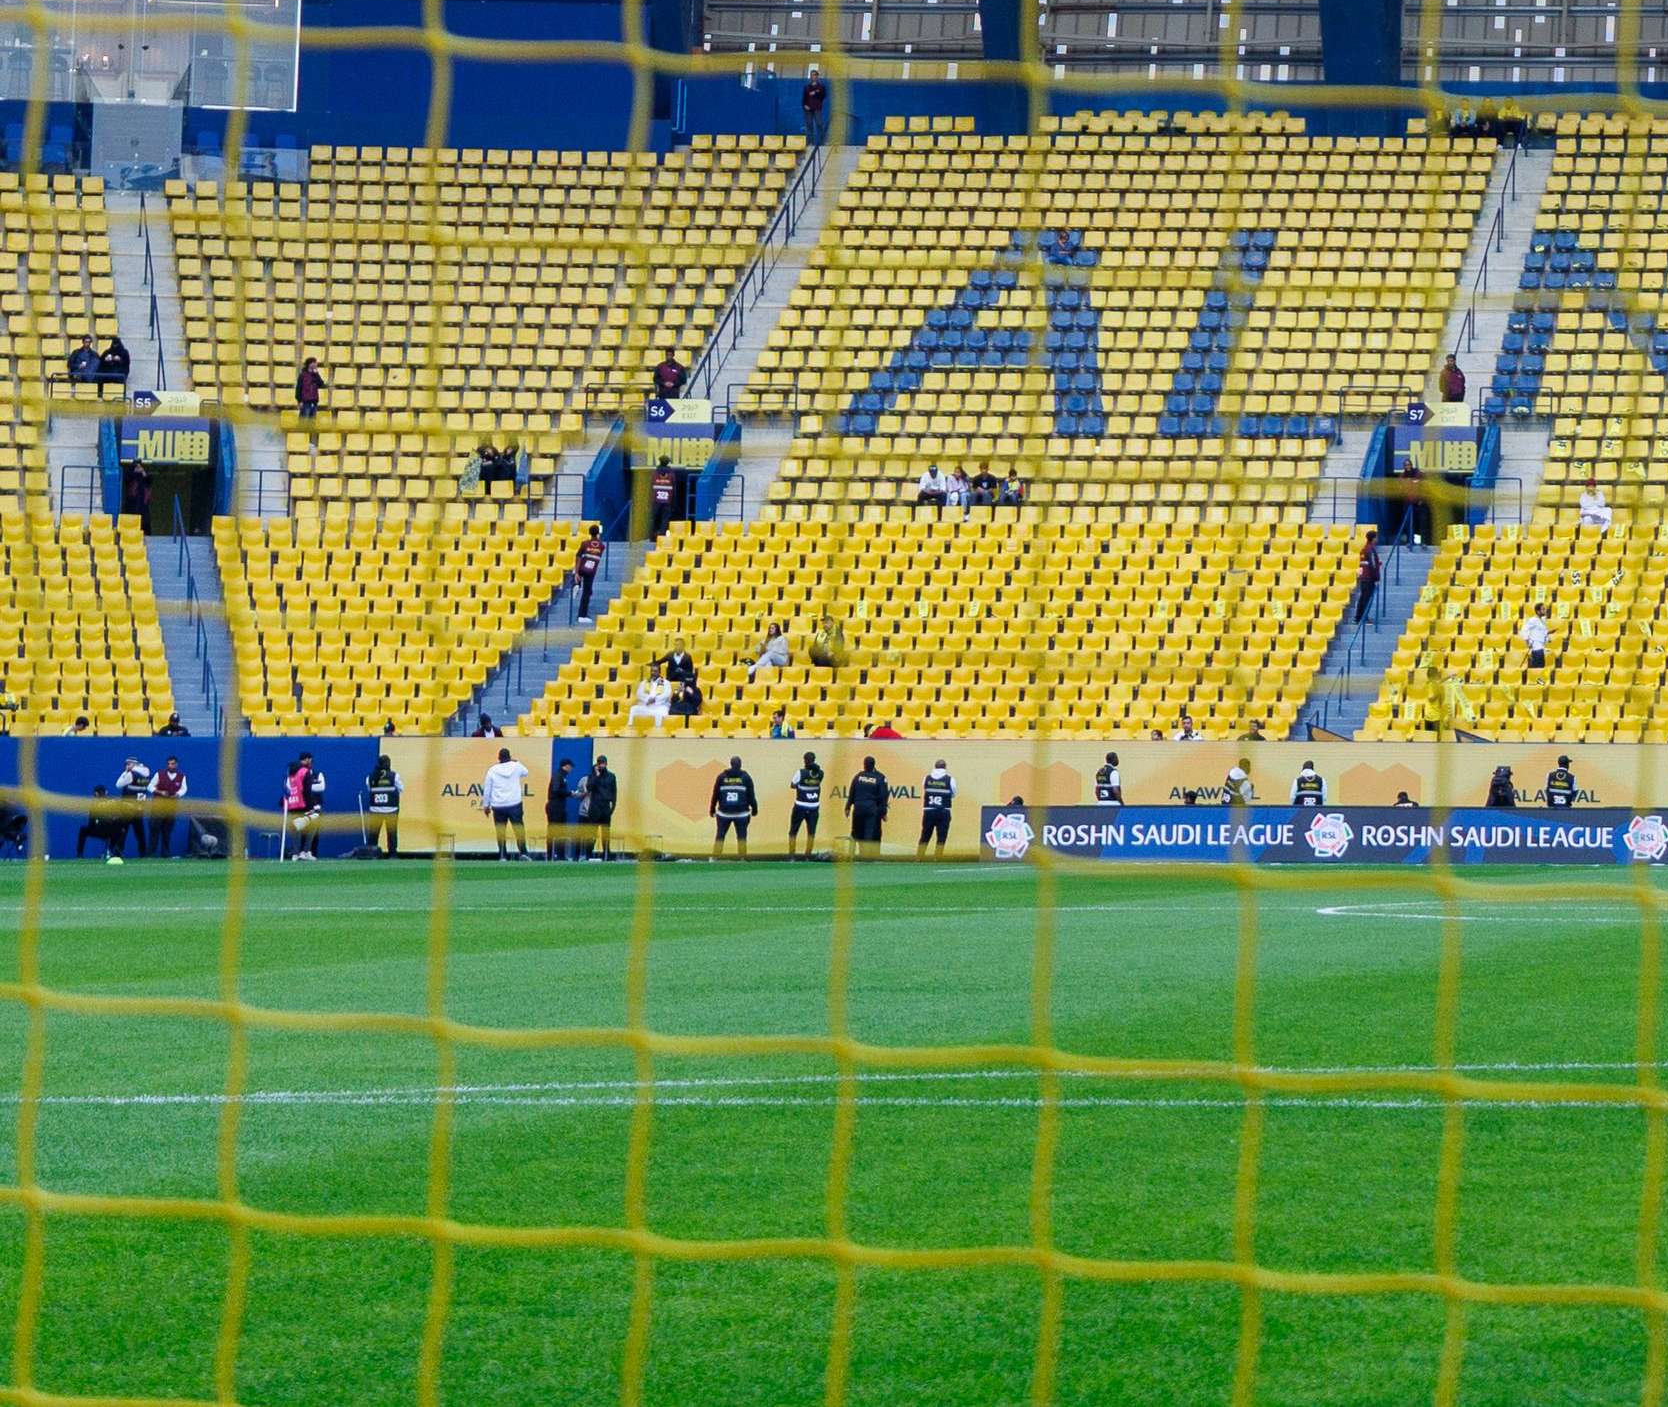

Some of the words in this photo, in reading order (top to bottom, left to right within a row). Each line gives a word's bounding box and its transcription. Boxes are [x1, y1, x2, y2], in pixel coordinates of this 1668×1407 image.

[834, 227, 1336, 439] AL
[135, 397, 152, 408] S5
[650, 406, 666, 417] S6
[1409, 409, 1424, 421] S7
[1042, 824, 1125, 846] ROSHN
[1131, 824, 1201, 846] SAUDI
[1206, 824, 1294, 846] LEAGUE
[1362, 825, 1445, 847] ROSHN
[1450, 826, 1521, 848] SAUDI
[1526, 826, 1614, 848] LEAGUE
